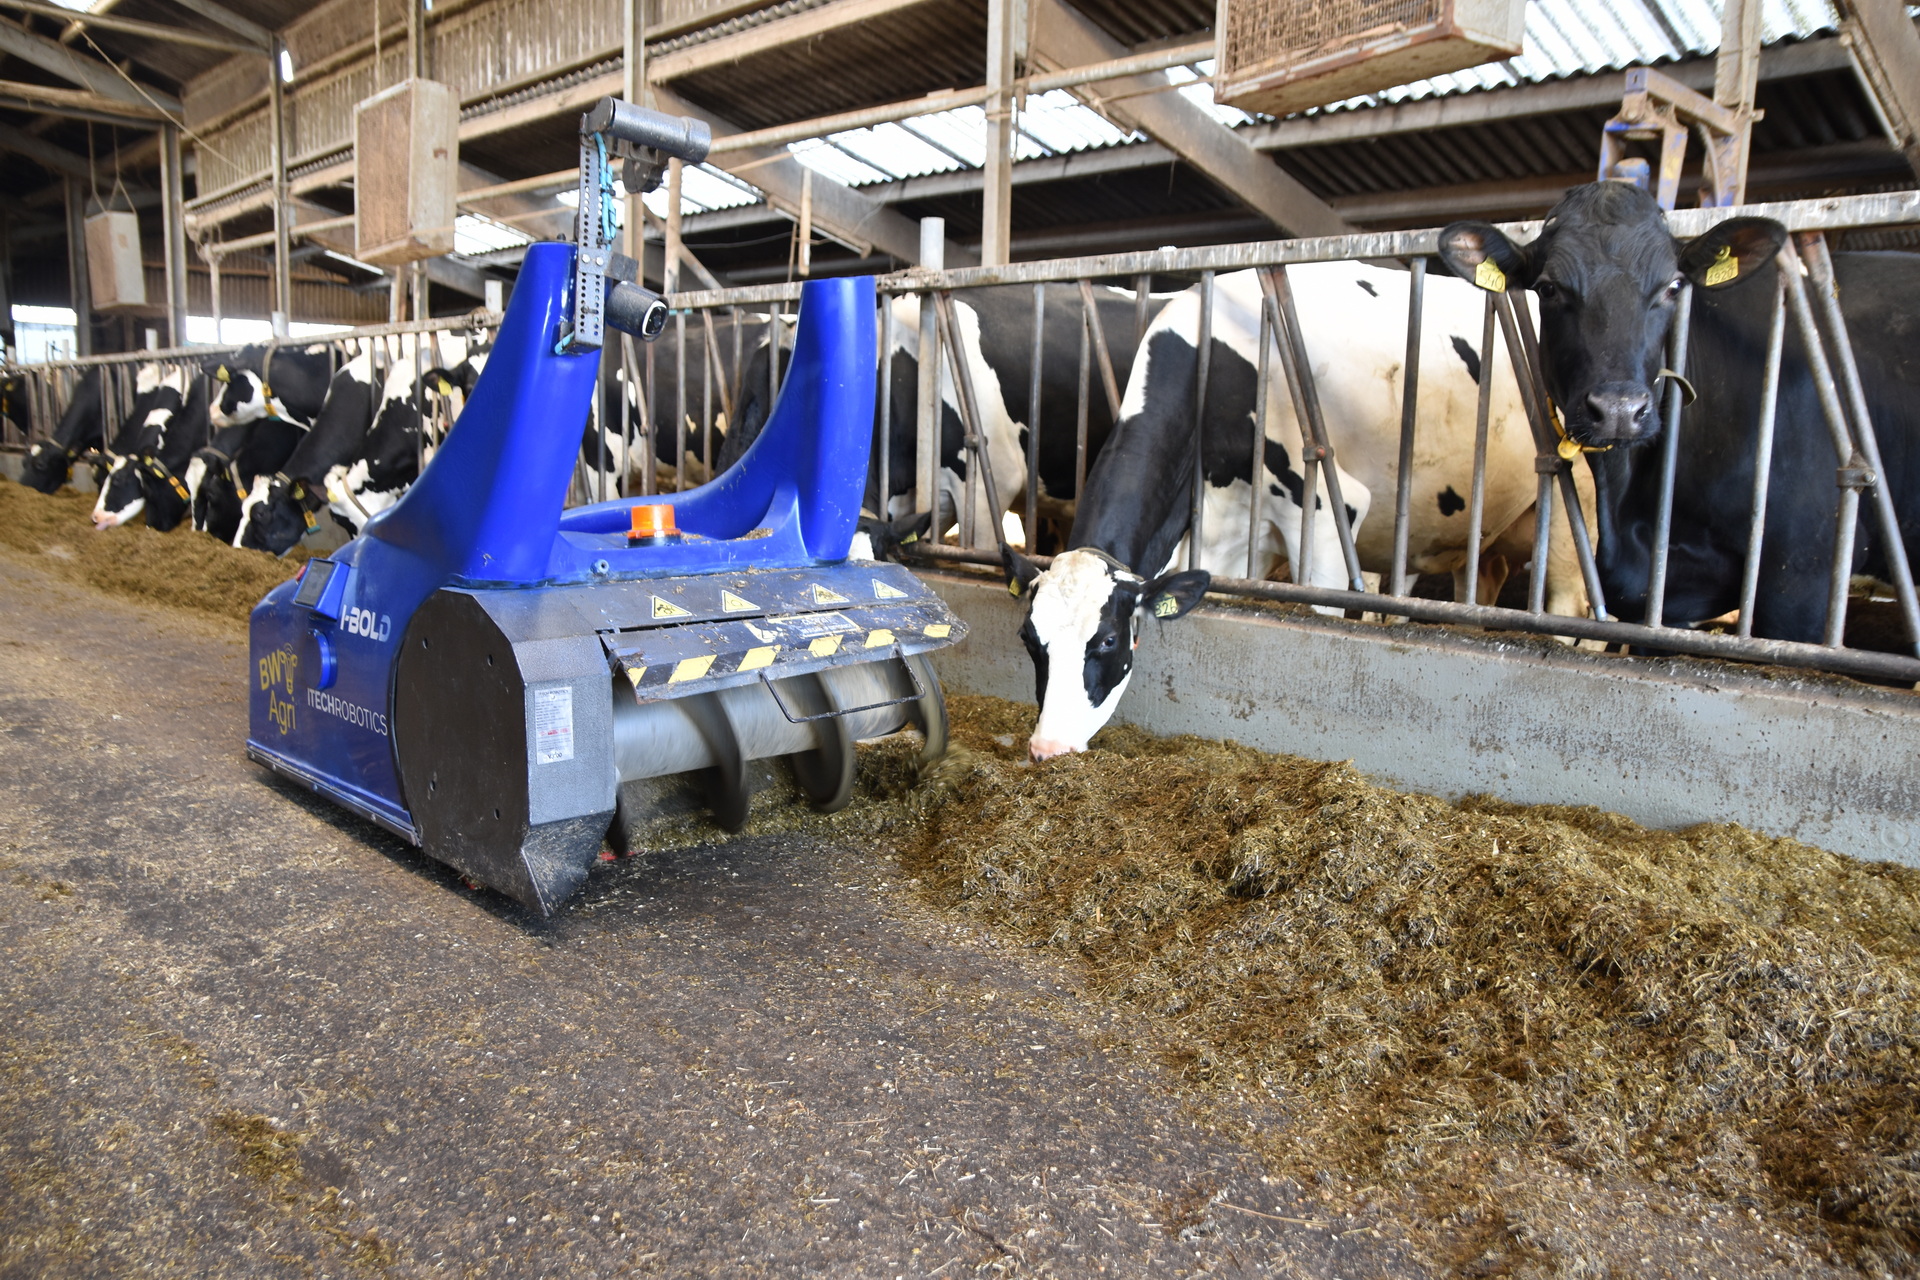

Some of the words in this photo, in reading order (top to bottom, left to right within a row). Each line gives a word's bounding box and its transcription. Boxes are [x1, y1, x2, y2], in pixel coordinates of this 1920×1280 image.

[340, 604, 391, 642] I-BOLD
[268, 689, 296, 735] Agri
[307, 687, 388, 736] ITECHROBOTICS
